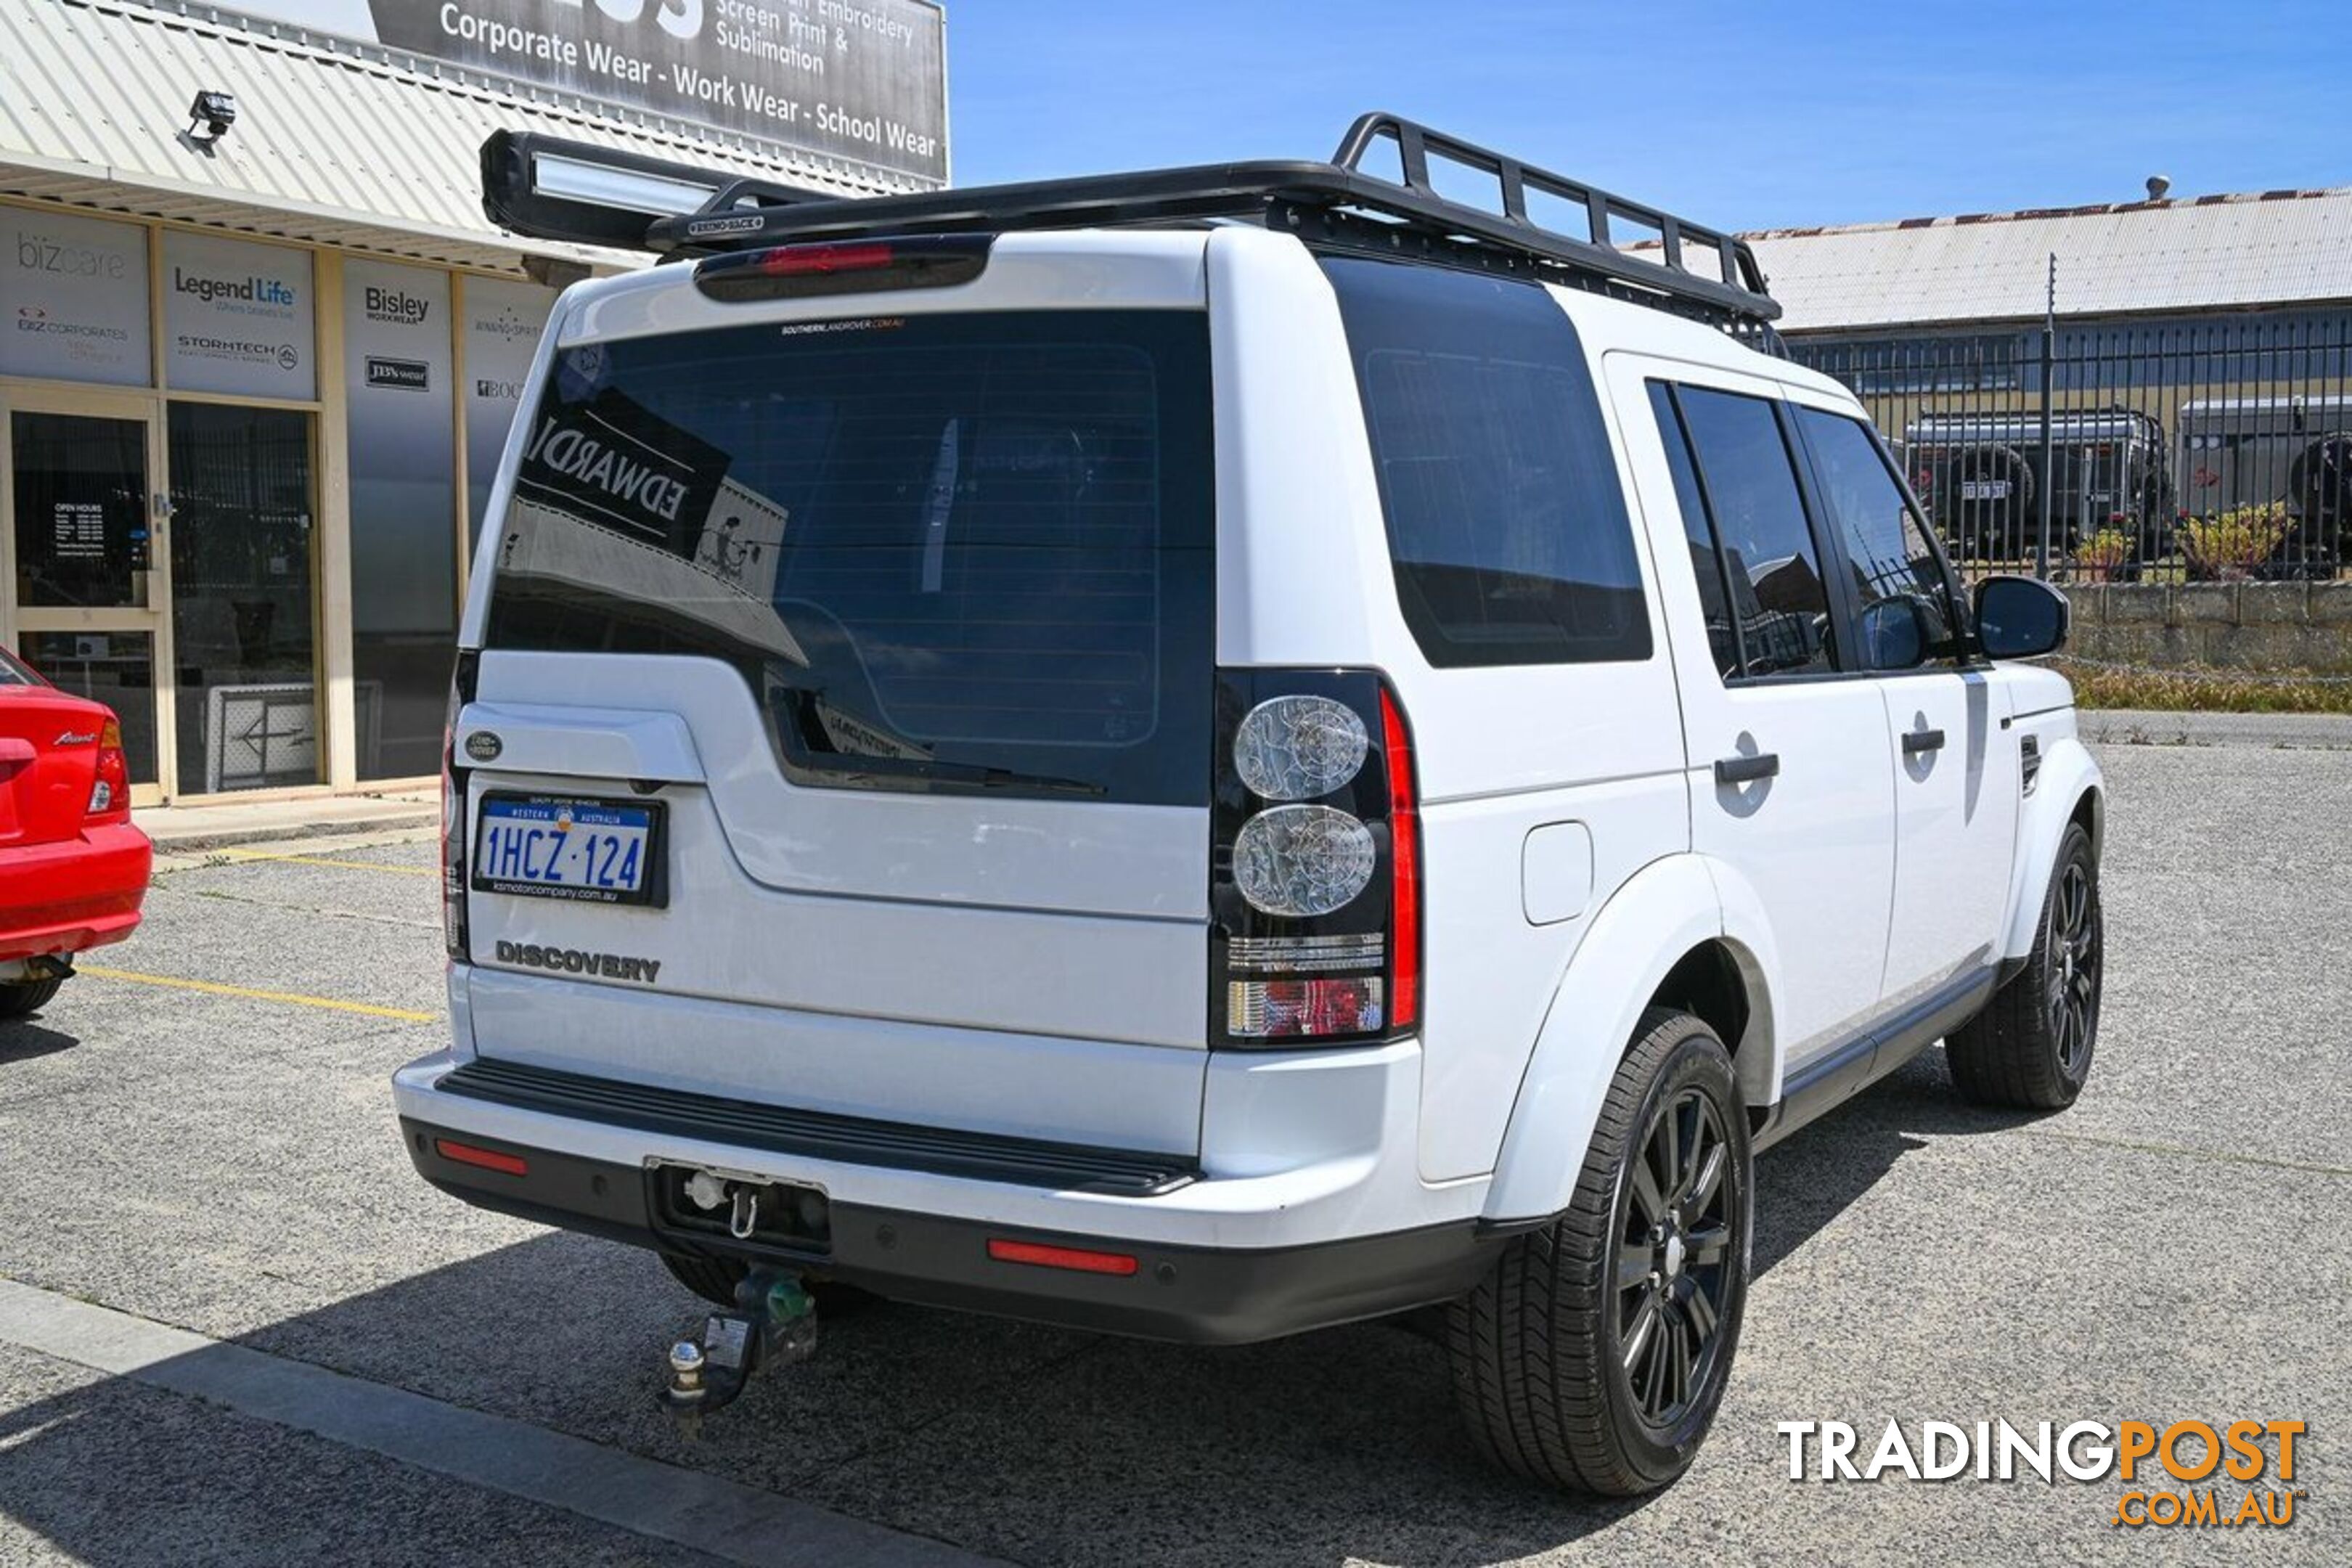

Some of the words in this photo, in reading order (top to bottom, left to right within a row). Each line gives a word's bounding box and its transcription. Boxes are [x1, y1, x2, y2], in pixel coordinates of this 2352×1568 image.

[716, 0, 779, 30] Screen
[788, 12, 827, 45] Print
[835, 27, 848, 52] &
[818, 0, 912, 47] Embroidery
[716, 20, 823, 74] Sublimation
[441, 3, 578, 65] Corporate
[585, 39, 652, 83] Wear
[672, 64, 735, 107] Work
[740, 82, 798, 122] Wear
[816, 103, 881, 144] School
[886, 121, 936, 158] Wear
[18, 233, 125, 279] bizcare
[175, 266, 253, 301] Legend
[366, 287, 429, 322] Bisley
[179, 337, 275, 355] STORMTECH
[490, 380, 526, 400] BOC
[497, 940, 661, 983] DISCOVERY
